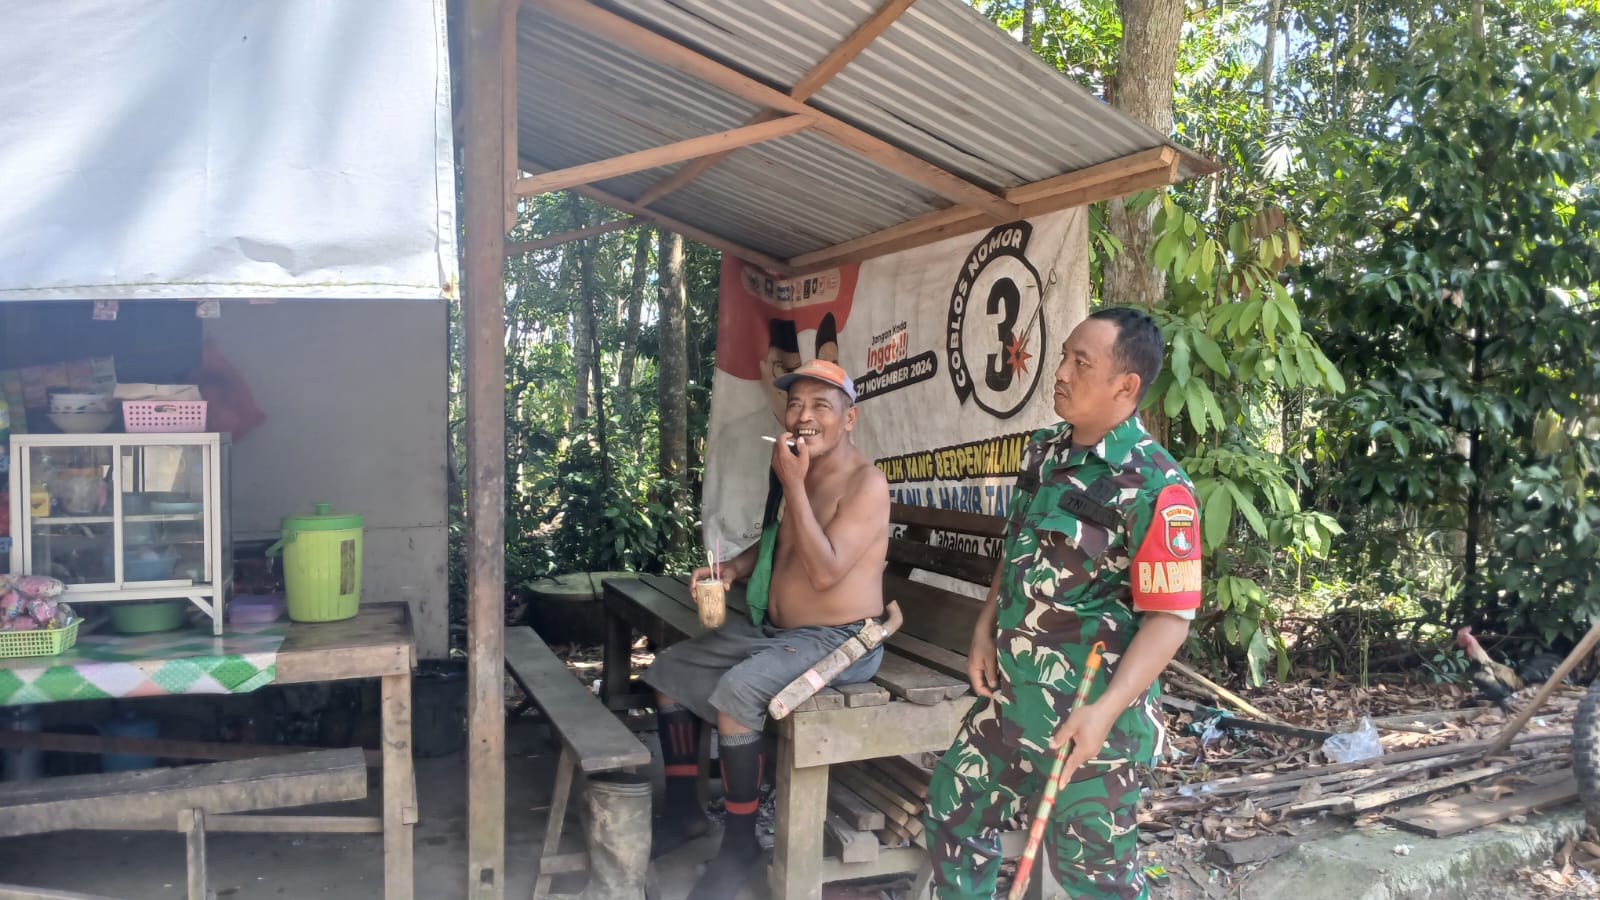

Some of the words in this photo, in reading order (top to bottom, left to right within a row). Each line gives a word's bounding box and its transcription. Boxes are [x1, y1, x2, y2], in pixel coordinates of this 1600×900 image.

[950, 280, 968, 388] COBLOS
[967, 228, 1023, 277] NOMOR
[871, 328, 893, 346] Jangan
[985, 277, 1021, 392] 3
[856, 383, 865, 397] 27
[865, 366, 909, 393] NOVEMBER
[910, 357, 933, 378] 2024
[904, 453, 934, 479] YANG
